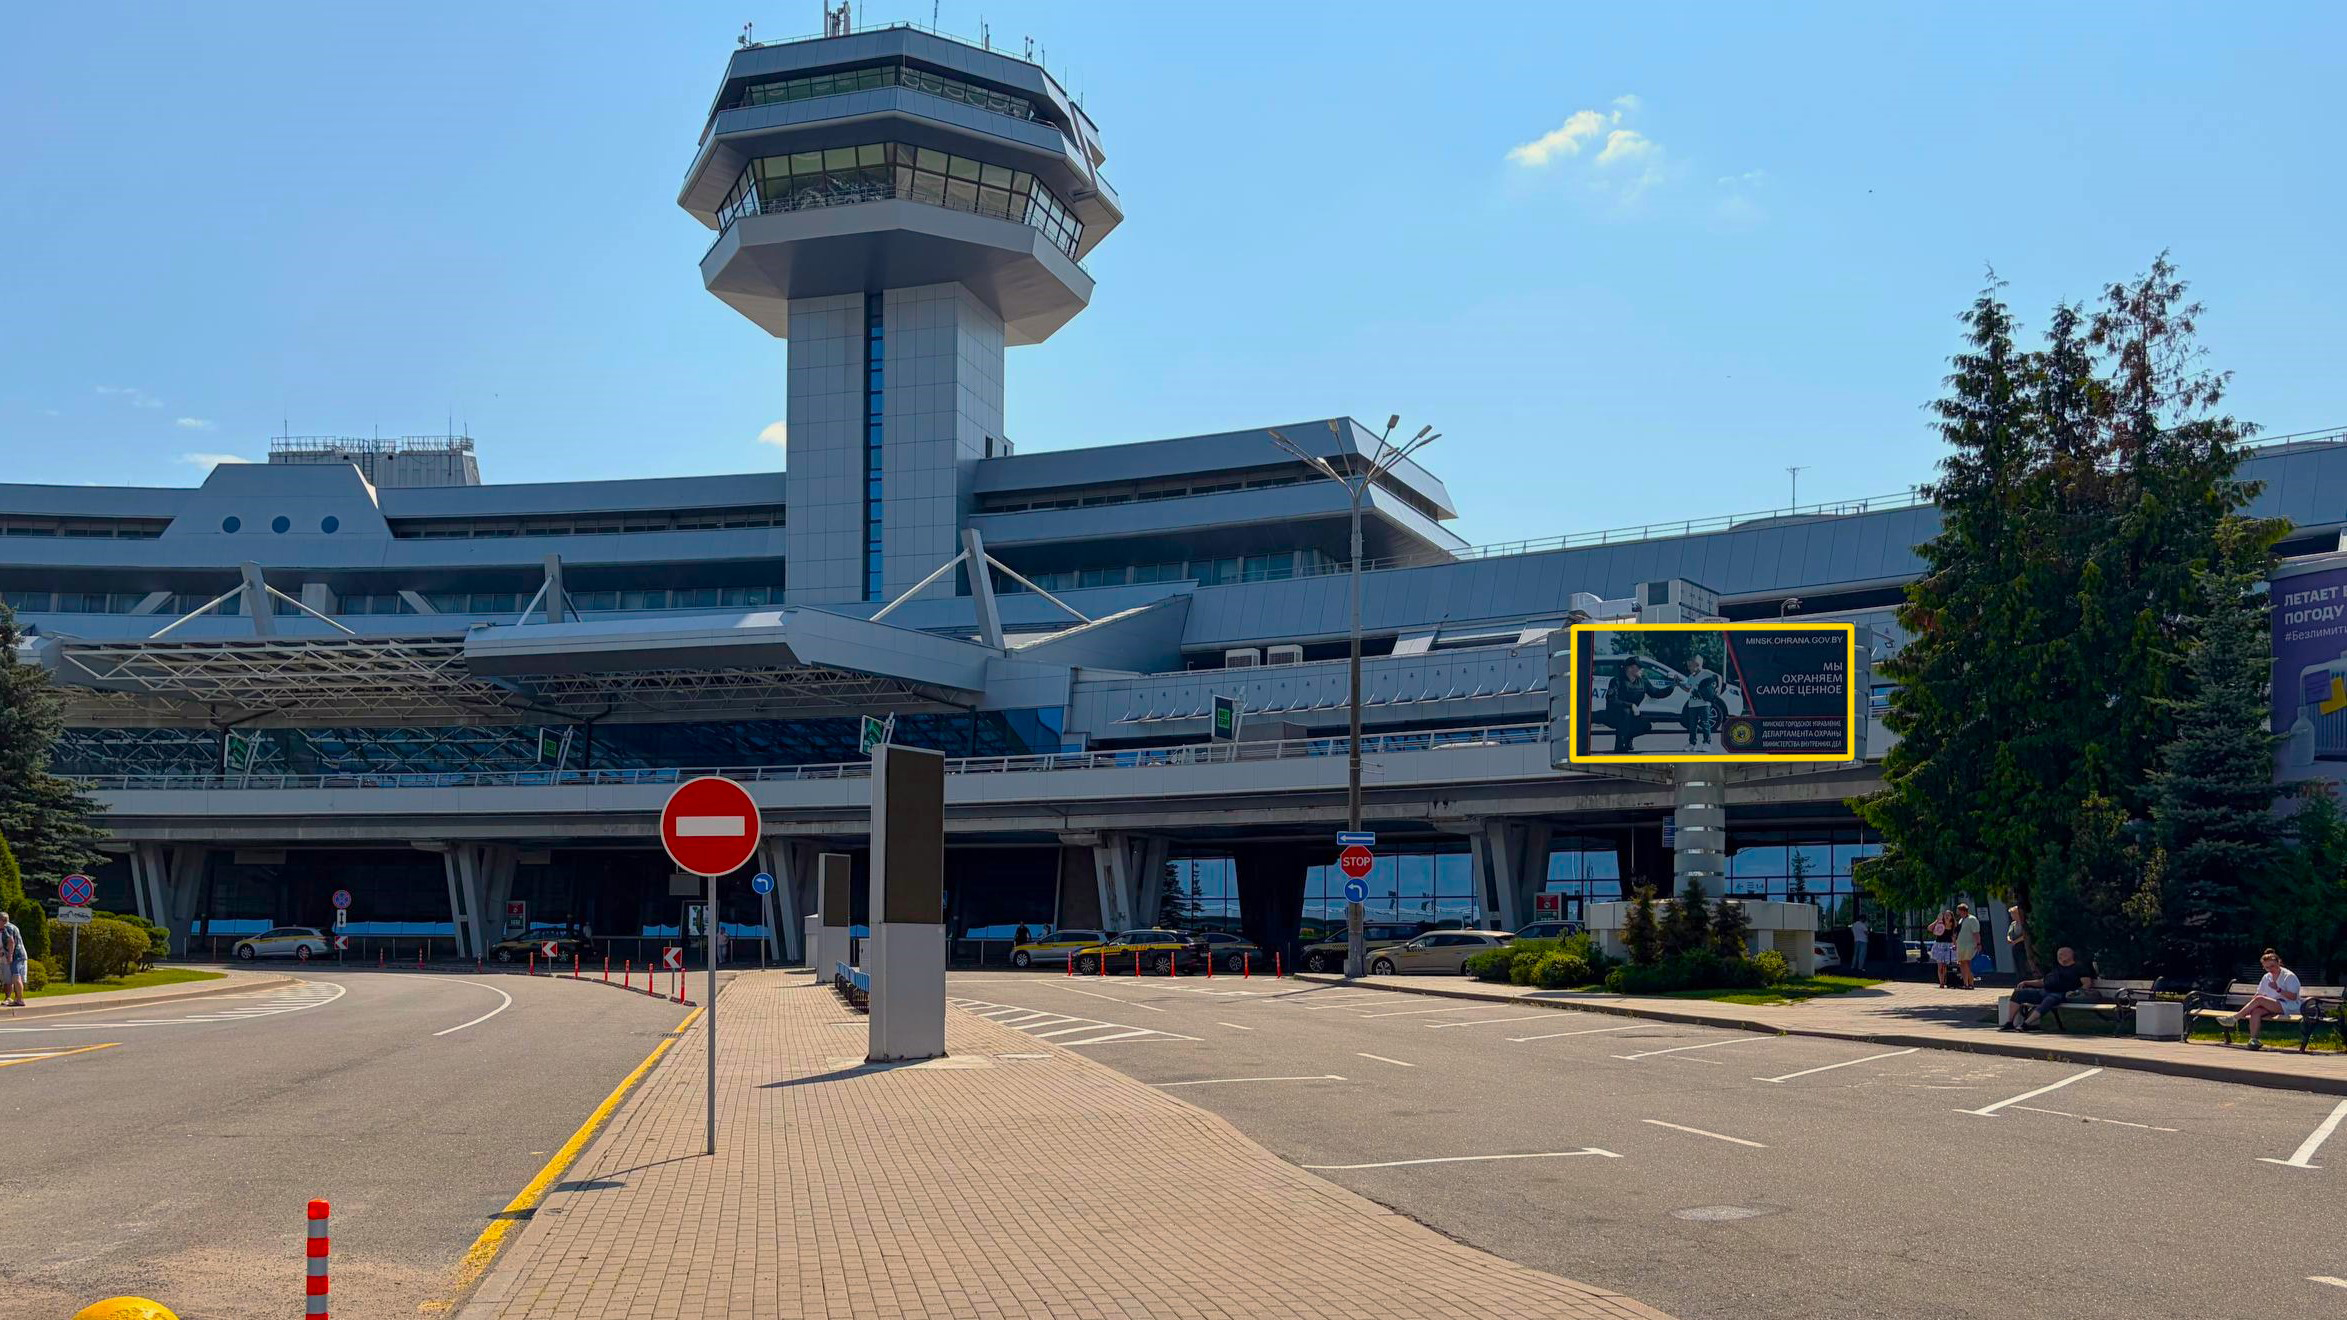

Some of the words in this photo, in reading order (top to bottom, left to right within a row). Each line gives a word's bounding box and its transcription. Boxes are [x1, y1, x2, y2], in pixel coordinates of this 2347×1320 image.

[2283, 586, 2339, 607] ЛЕТАЕТ
[2284, 604, 2345, 625] ПОГОДУ
[1823, 662, 1843, 671] МЫ
[1782, 674, 1843, 683] ОХРАНЯЕМ
[1756, 685, 1795, 695] САМОЕ
[1797, 685, 1843, 696] ЦЕННОЕ
[1762, 730, 1813, 738] ДЕПАРТАМЕНТА
[1814, 729, 1842, 737] ОХРАНЫ
[1343, 857, 1371, 867] STOP
